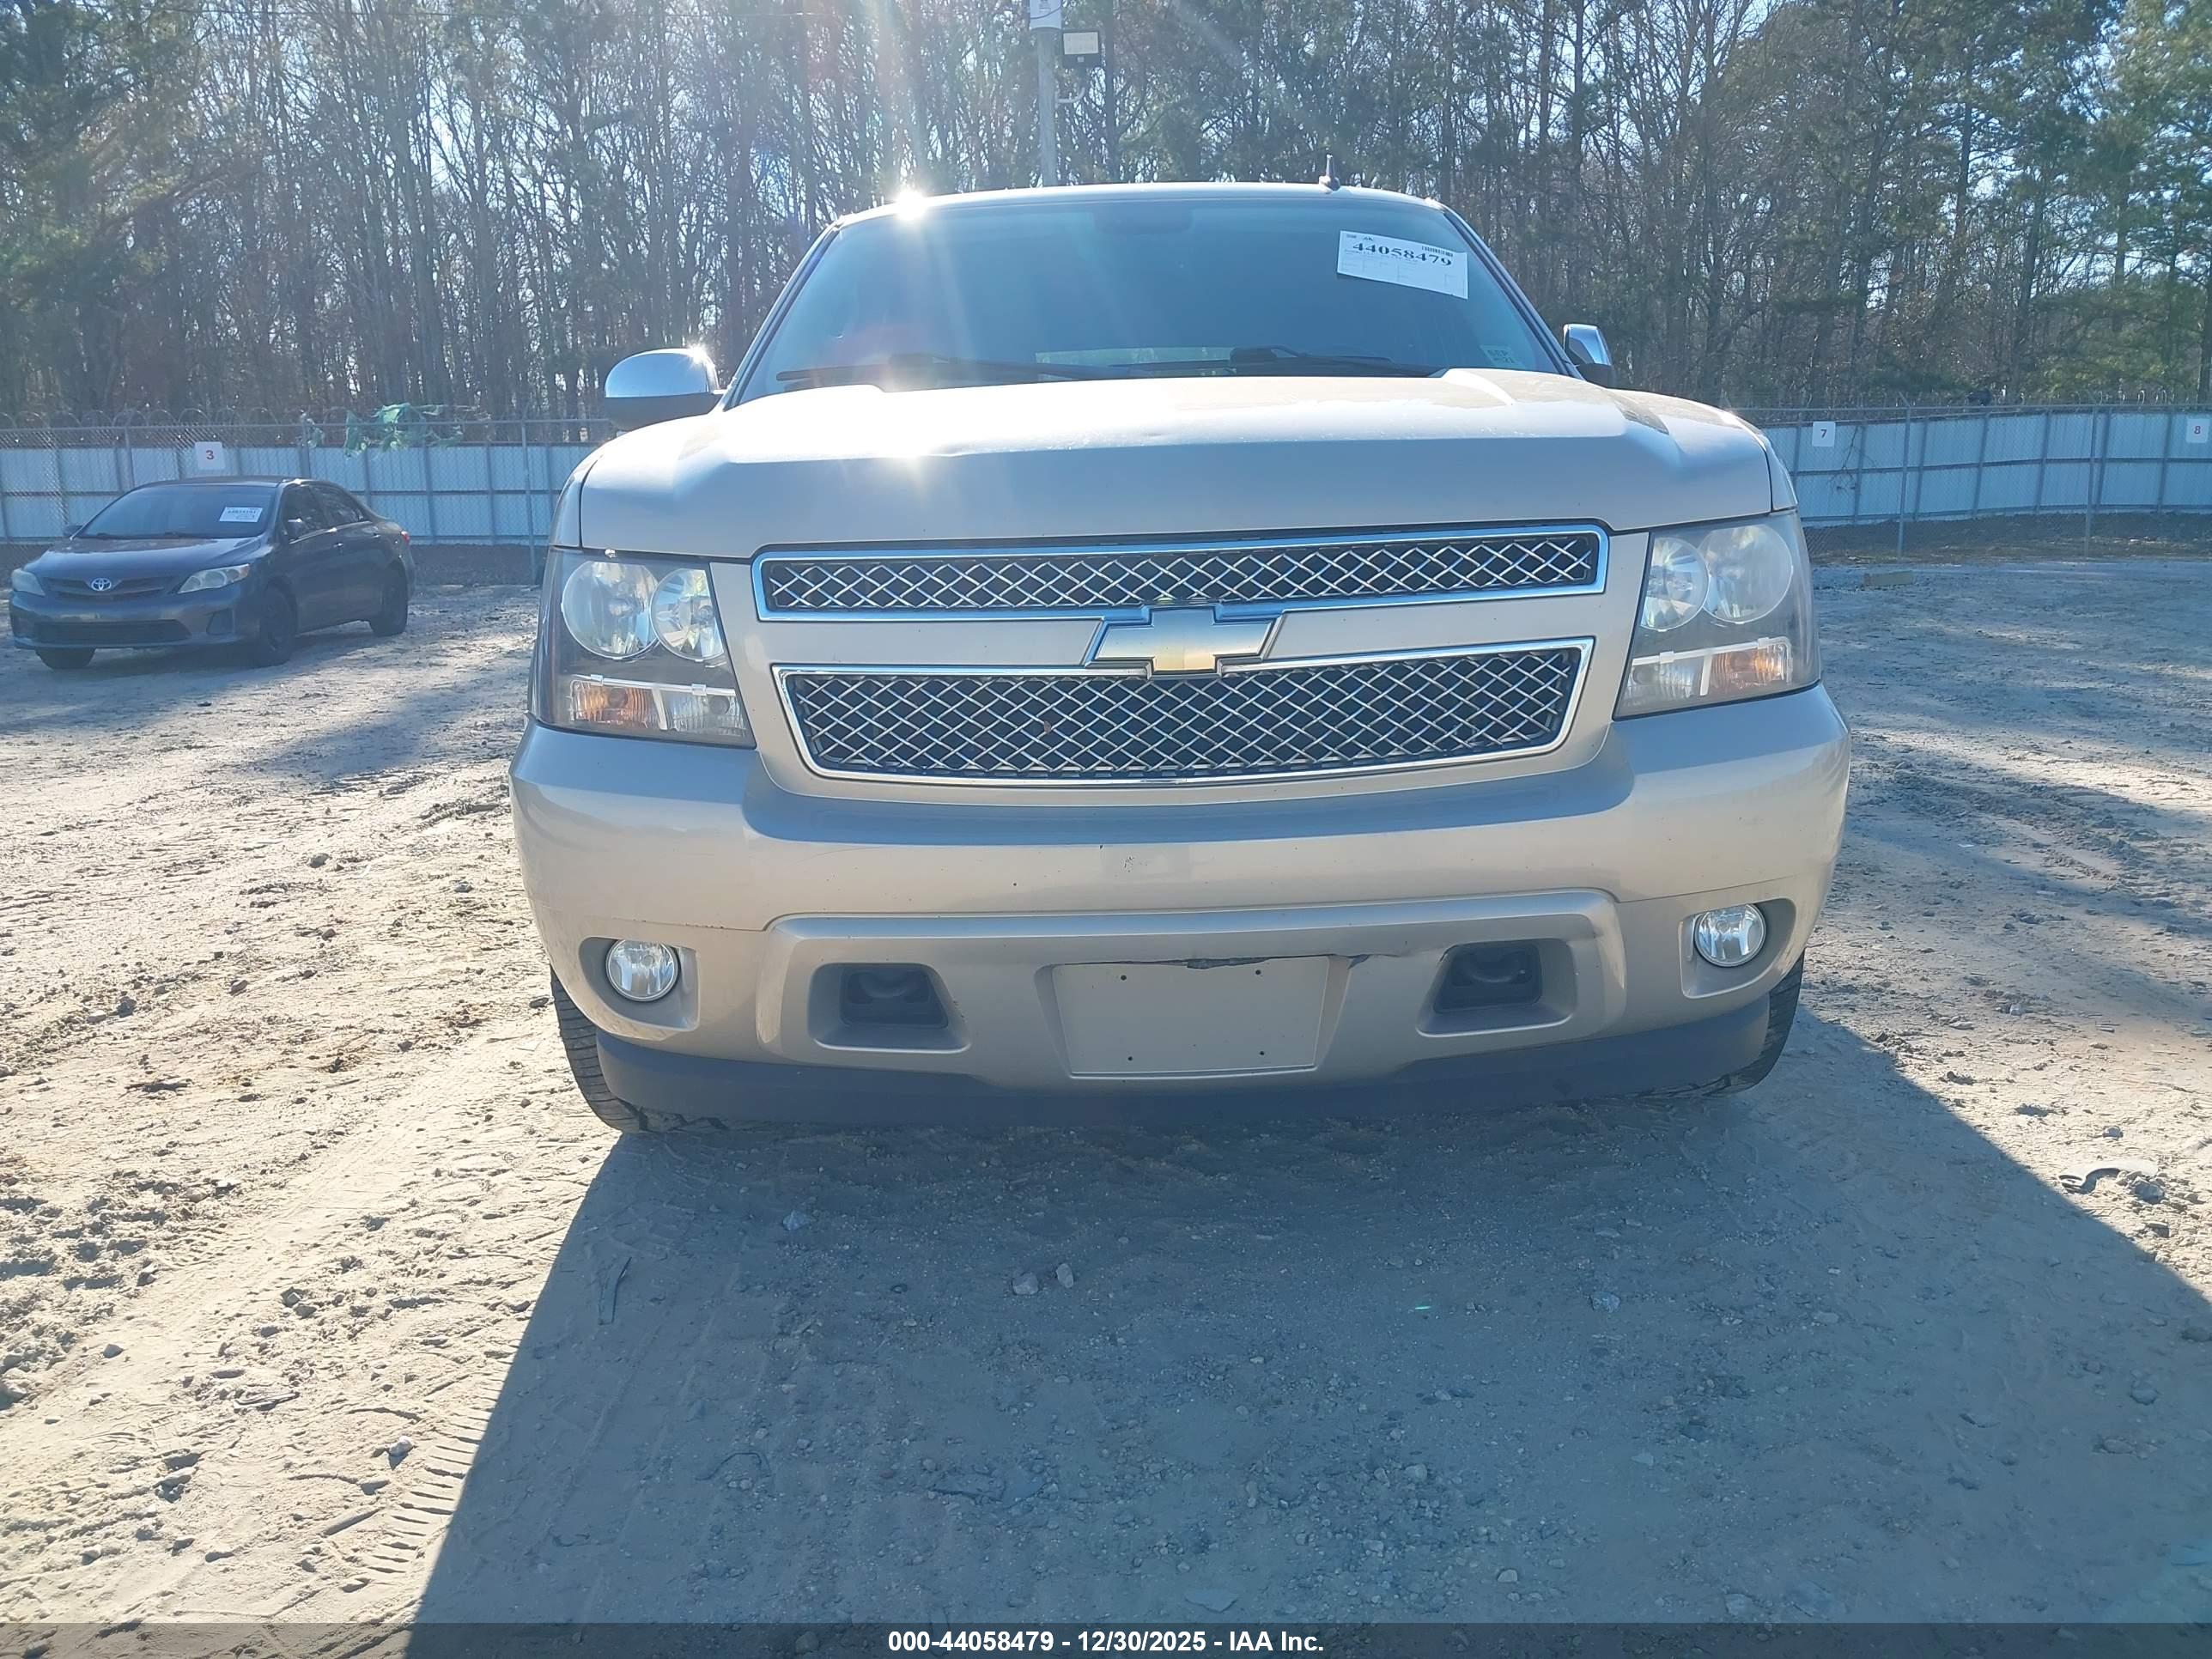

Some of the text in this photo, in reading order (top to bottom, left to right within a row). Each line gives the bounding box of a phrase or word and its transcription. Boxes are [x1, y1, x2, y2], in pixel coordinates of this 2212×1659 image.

[1352, 242, 1452, 266] 44058479
[1820, 428, 1827, 438] 7
[2194, 425, 2201, 434] 8
[205, 449, 215, 460] 3
